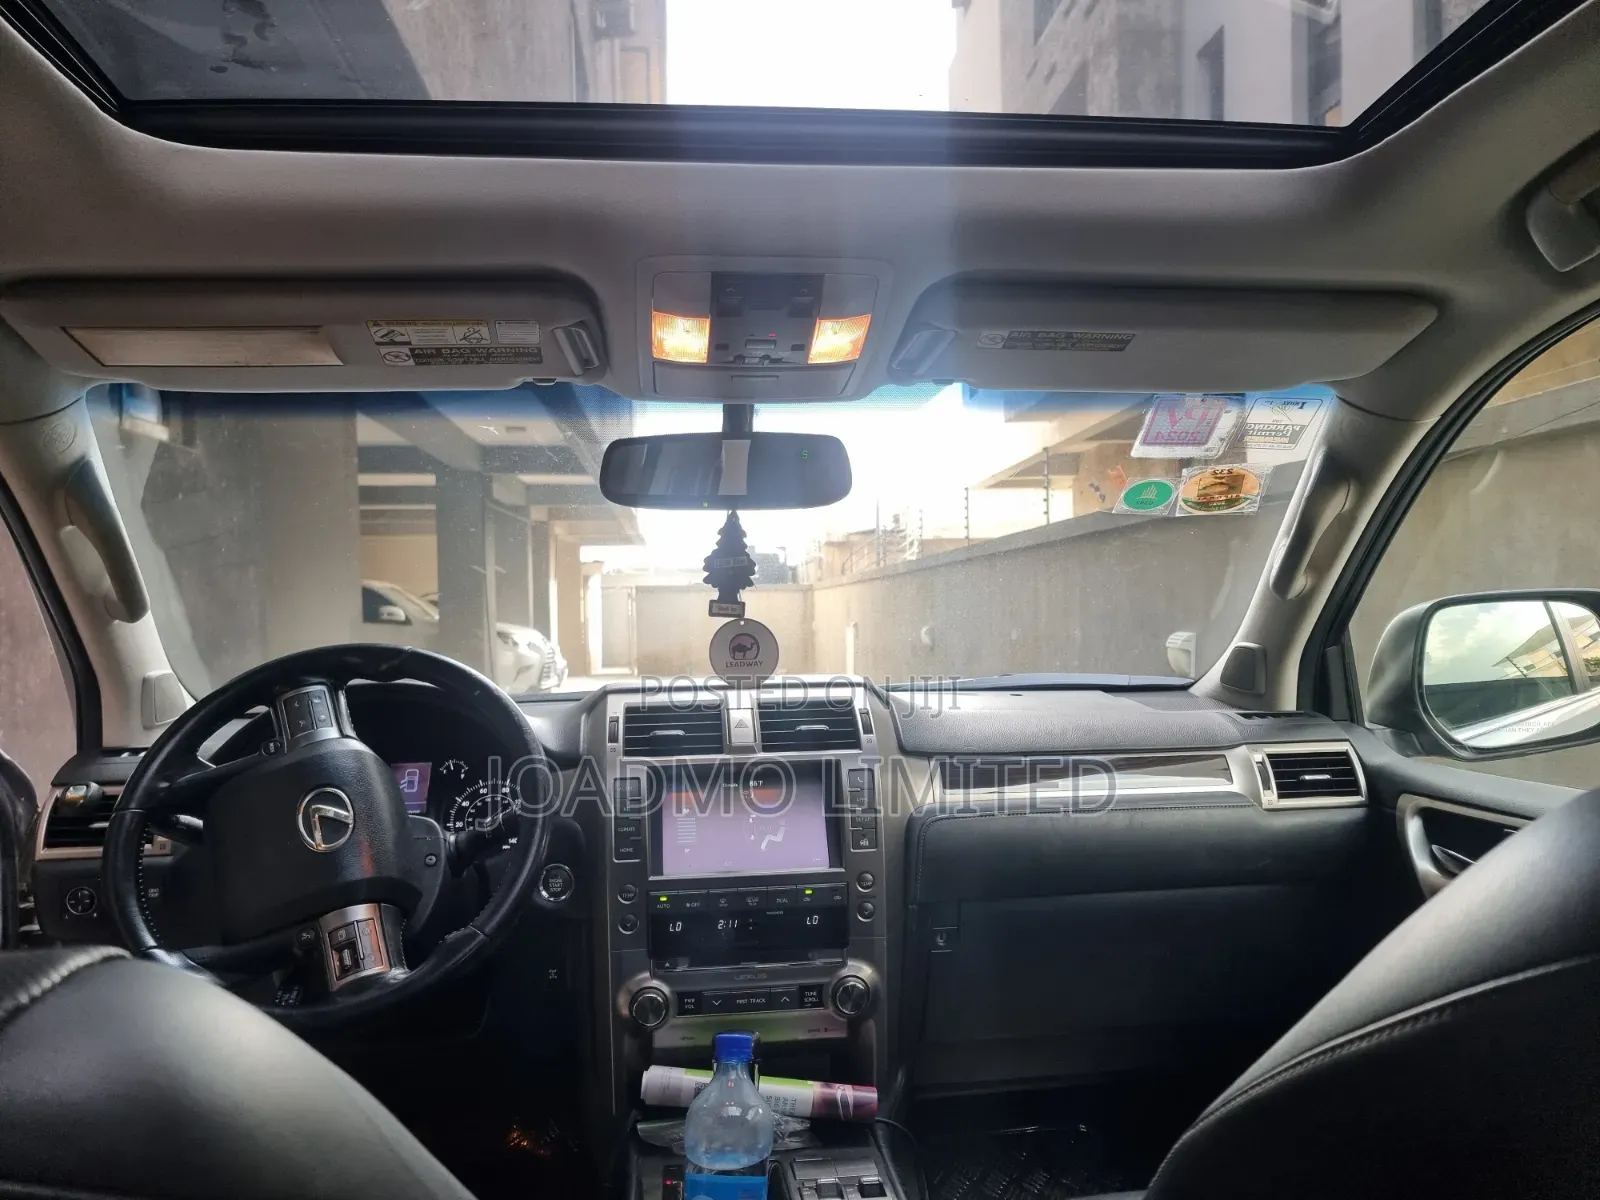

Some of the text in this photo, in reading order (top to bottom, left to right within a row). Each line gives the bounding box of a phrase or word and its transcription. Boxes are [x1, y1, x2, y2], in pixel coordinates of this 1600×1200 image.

[802, 450, 808, 460] S
[725, 660, 763, 668] LEADWAY
[718, 920, 738, 929] 2:11
[806, 916, 819, 925] LO
[669, 922, 682, 931] LO
[734, 972, 768, 980] LEXUS
